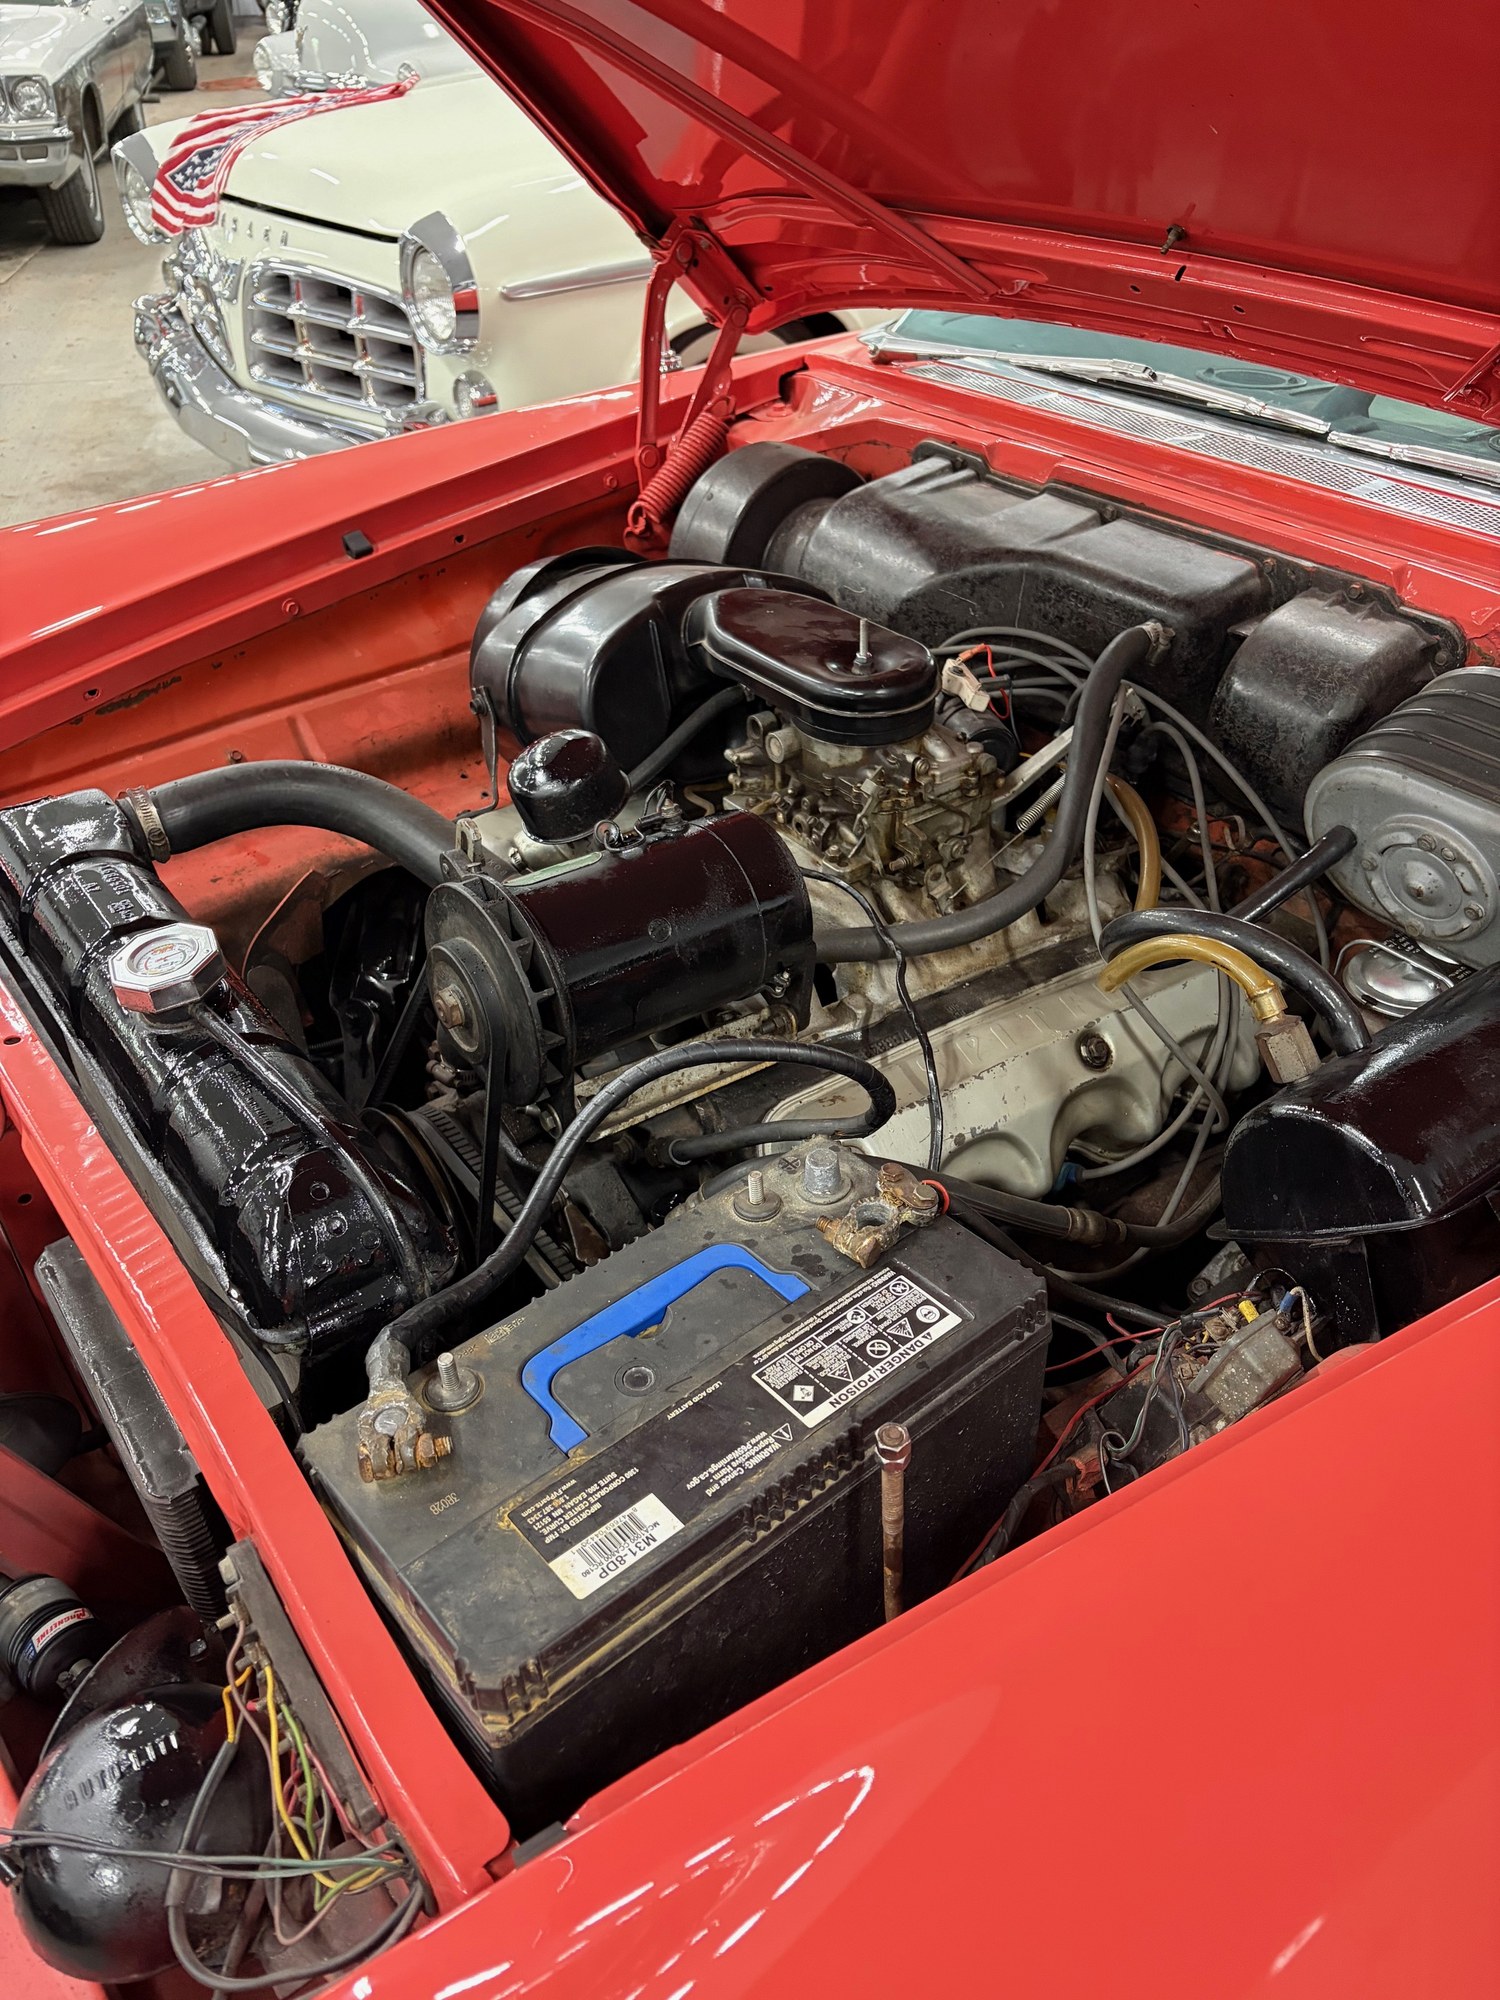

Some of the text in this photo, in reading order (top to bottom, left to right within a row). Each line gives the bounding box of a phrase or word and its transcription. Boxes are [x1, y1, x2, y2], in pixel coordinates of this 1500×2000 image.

[828, 1339, 924, 1408] DANGER/POISON
[665, 1379, 722, 1420] LEAD ACID BATTERY
[686, 1431, 768, 1490] www.P65Warnings.ca.gov
[705, 1440, 781, 1497] WARNING: Cancer and
[728, 1435, 775, 1468] Reproductive
[587, 1475, 626, 1503] CORPORATE
[596, 1471, 617, 1486] SUITE
[711, 1464, 734, 1480] Harm
[520, 1478, 577, 1517] www.FVPparts.com
[550, 1507, 564, 1517] MN
[562, 1500, 589, 1520] CENTER
[532, 1515, 552, 1530] 55121
[542, 1501, 602, 1543] IMPORTED BY: FMP
[581, 1520, 659, 1577] MCA1000 CCA800 RC180
[594, 1532, 657, 1579] M31-8DP
[36, 1608, 86, 1644] MAGNEFINE
